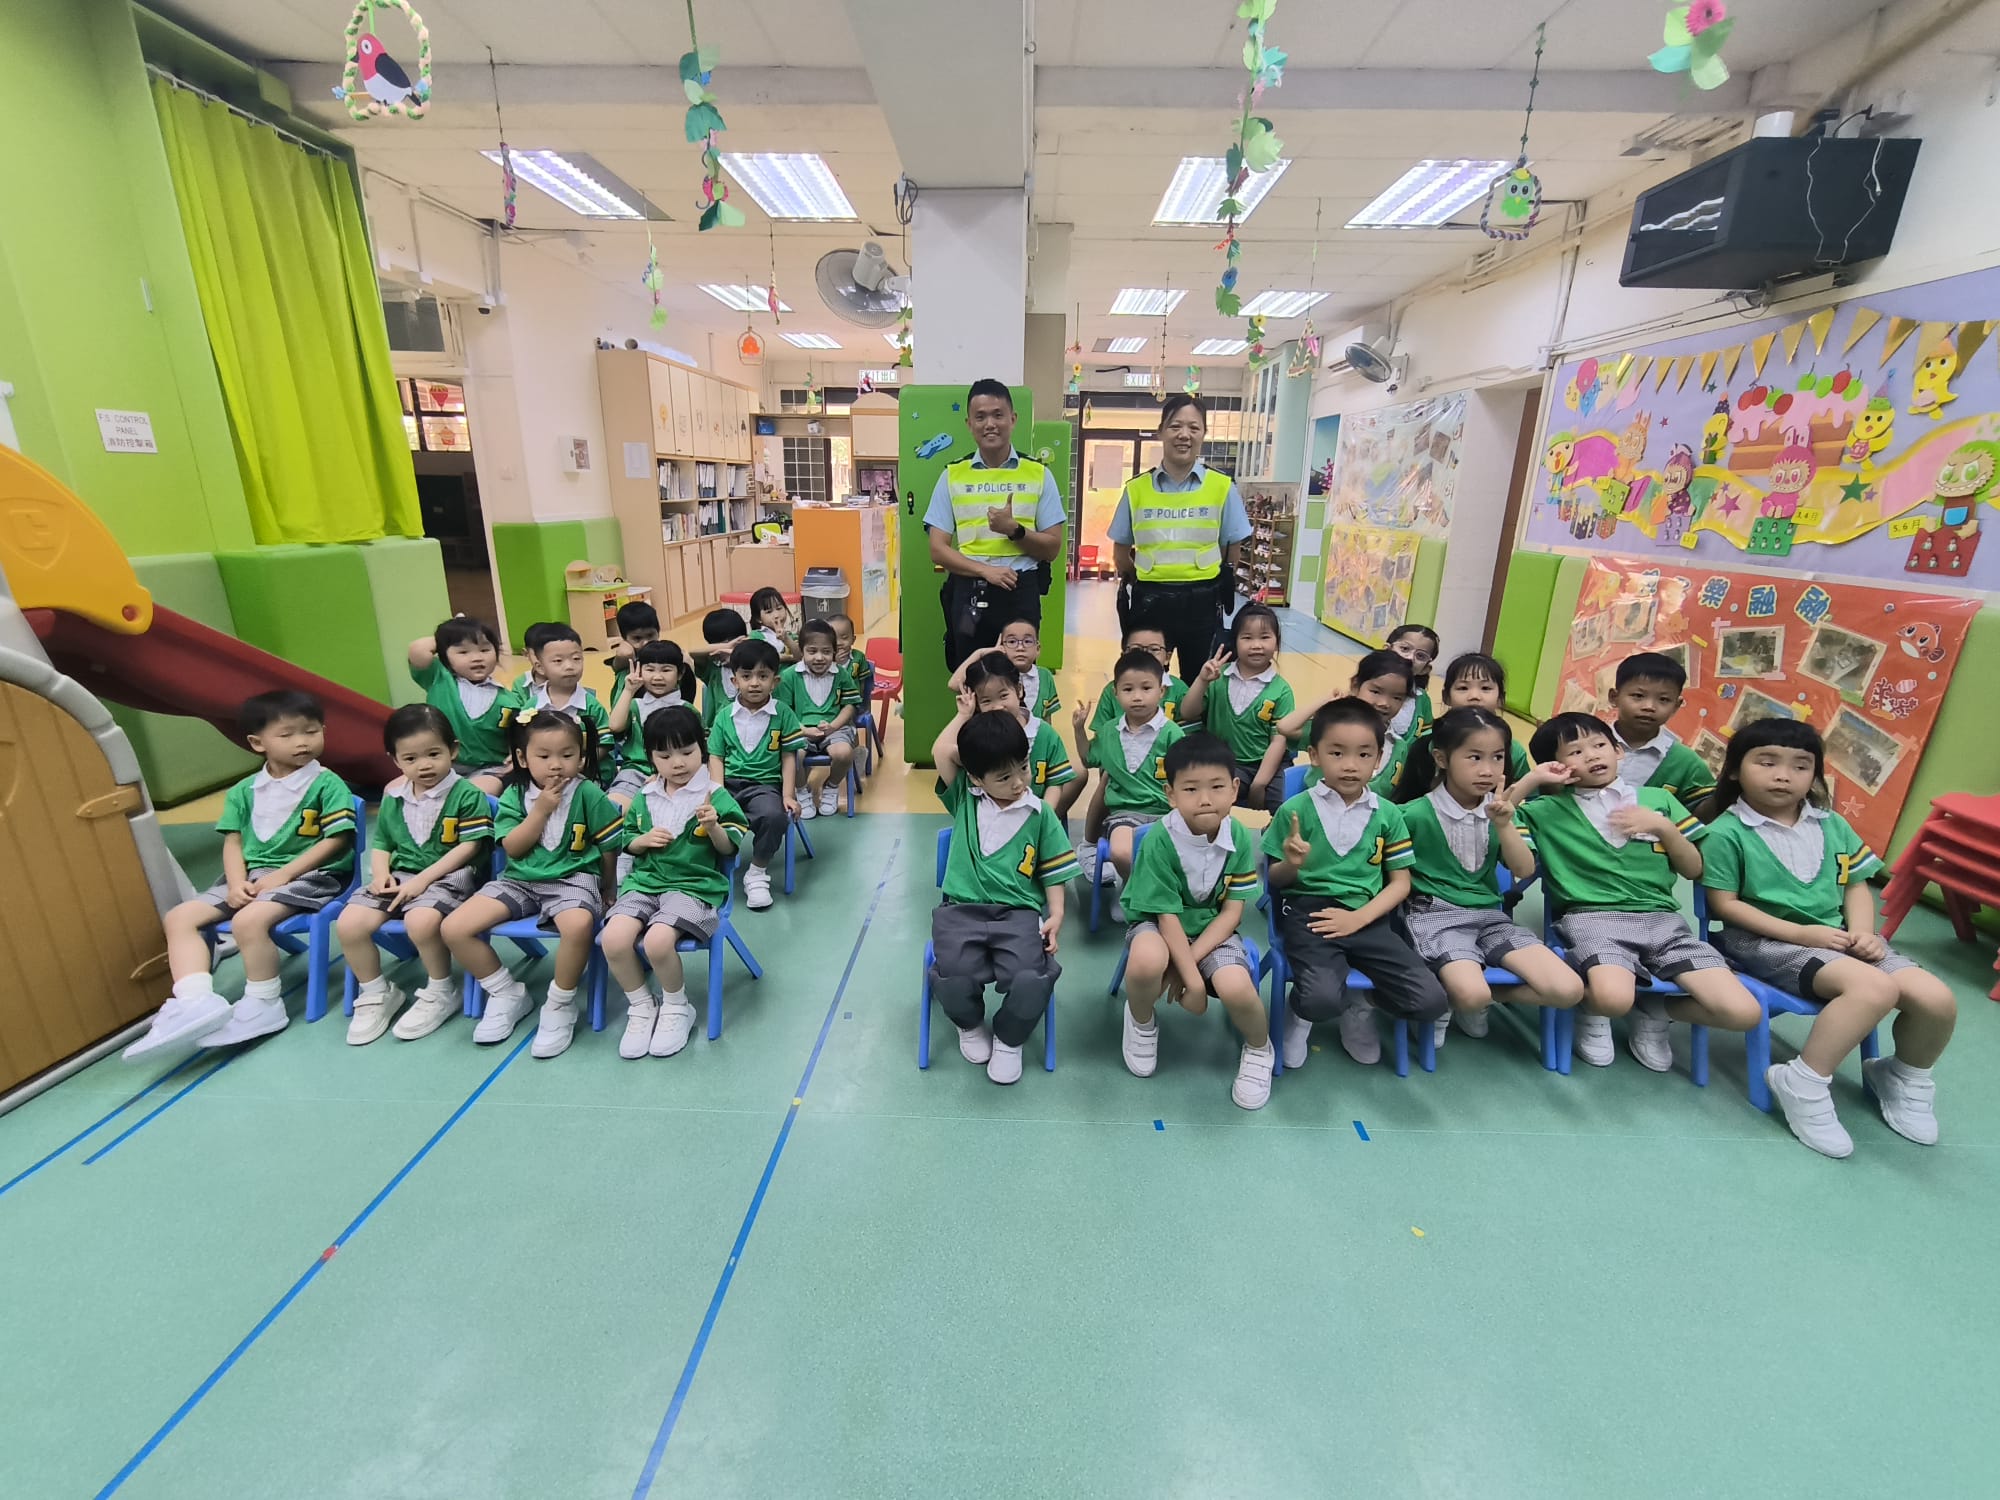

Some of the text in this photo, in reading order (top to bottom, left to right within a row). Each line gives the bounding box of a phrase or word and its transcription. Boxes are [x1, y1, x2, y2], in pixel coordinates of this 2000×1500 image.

[114, 414, 150, 425] CONTROL
[115, 426, 140, 436] PANEL
[977, 482, 1013, 493] POLICE
[1156, 507, 1195, 519] POLICE
